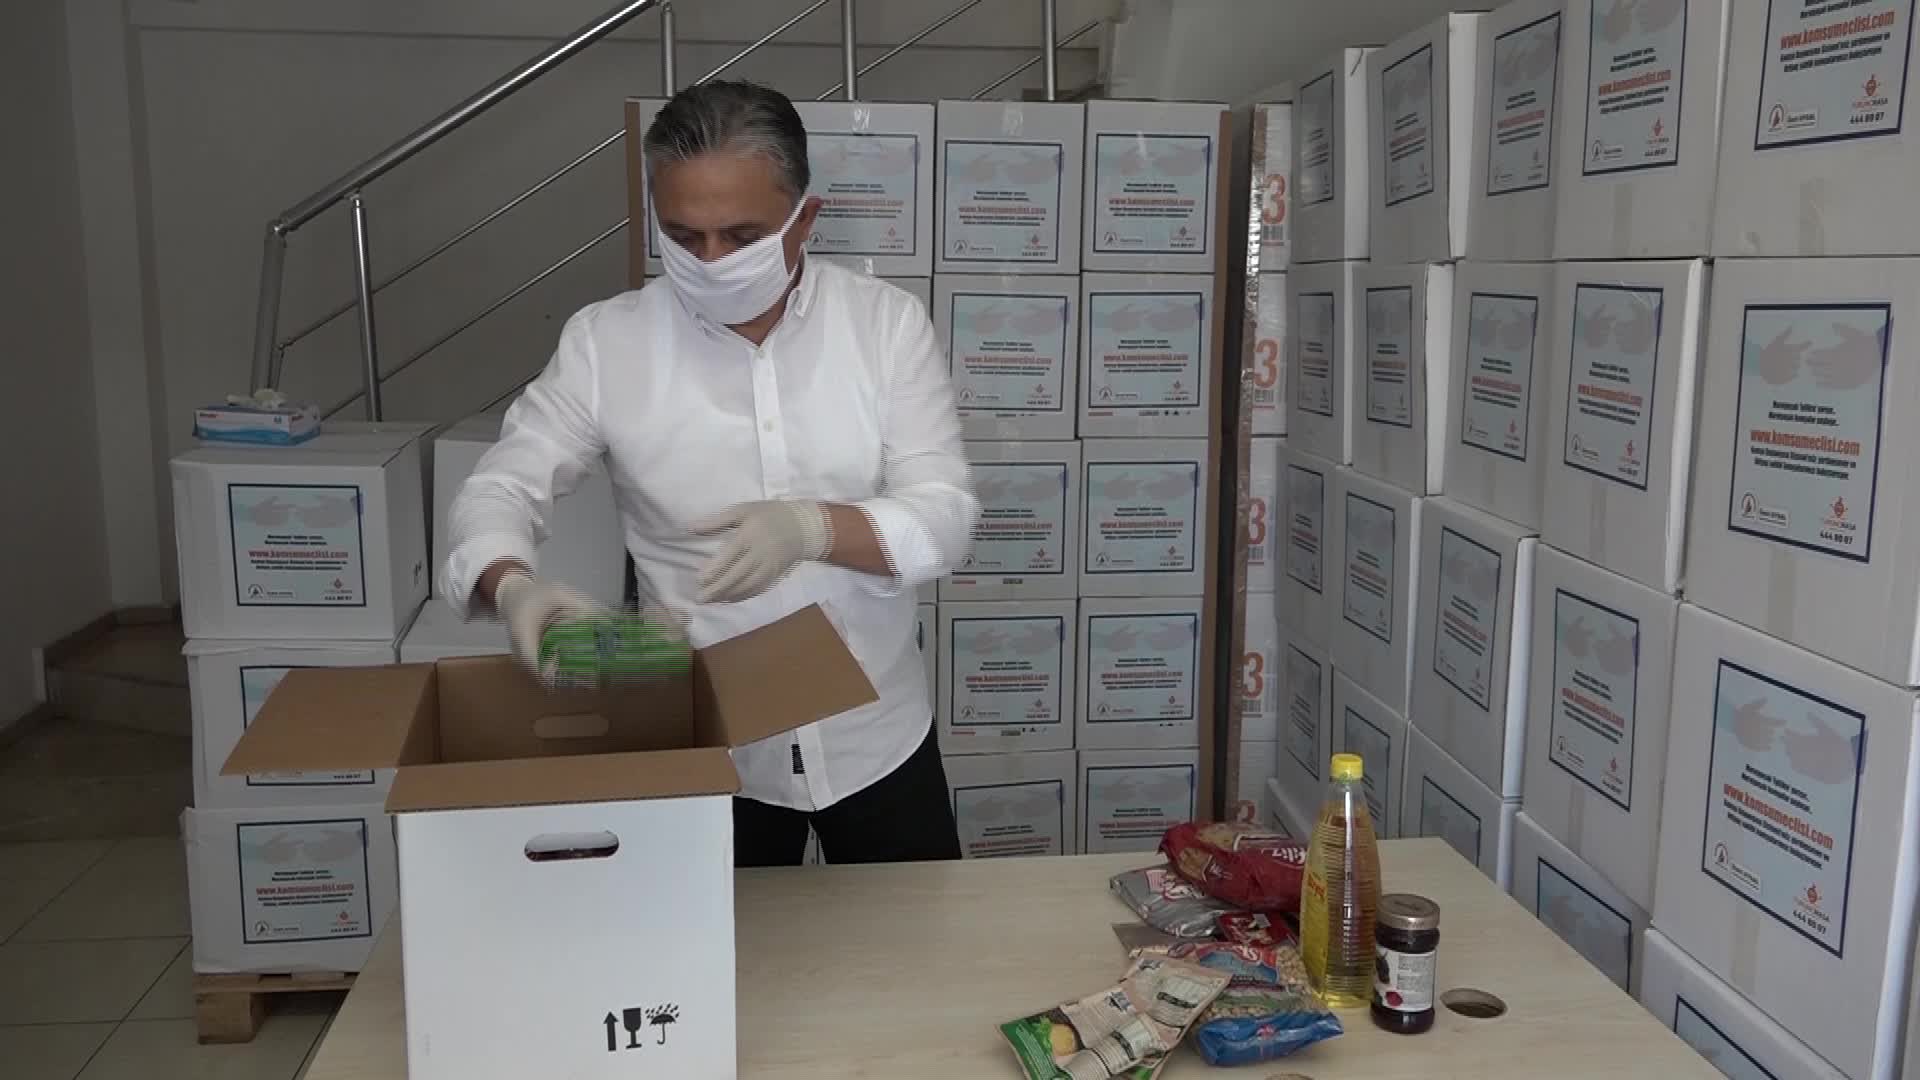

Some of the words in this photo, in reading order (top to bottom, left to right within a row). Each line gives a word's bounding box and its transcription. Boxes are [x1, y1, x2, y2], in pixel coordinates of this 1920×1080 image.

[1262, 174, 1285, 225] 3
[1256, 338, 1278, 388] 3
[1249, 497, 1266, 545] 3
[1242, 652, 1264, 699] 3
